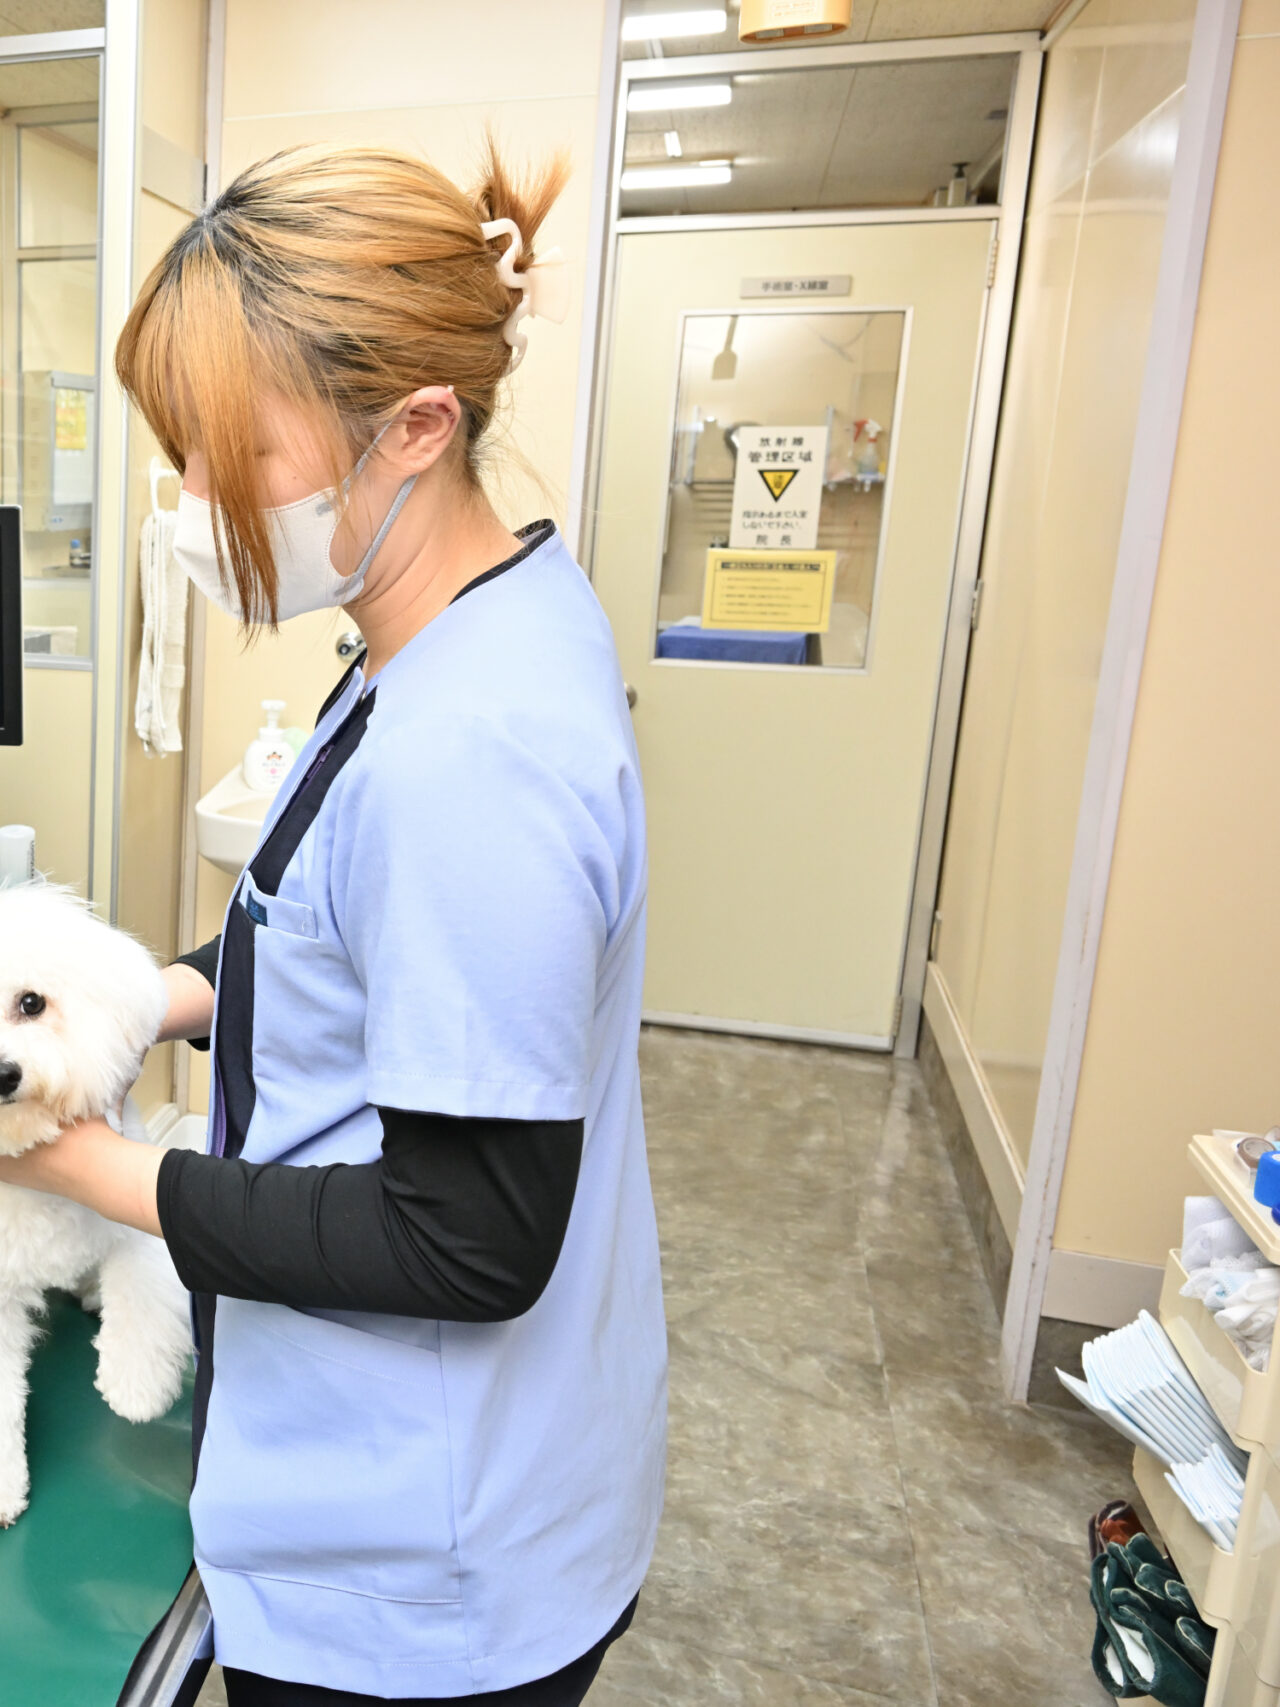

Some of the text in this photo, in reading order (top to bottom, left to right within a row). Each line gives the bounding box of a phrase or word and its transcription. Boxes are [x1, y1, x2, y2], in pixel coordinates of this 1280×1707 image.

[748, 450, 813, 464] 管理区域
[755, 534, 793, 546] 院長
